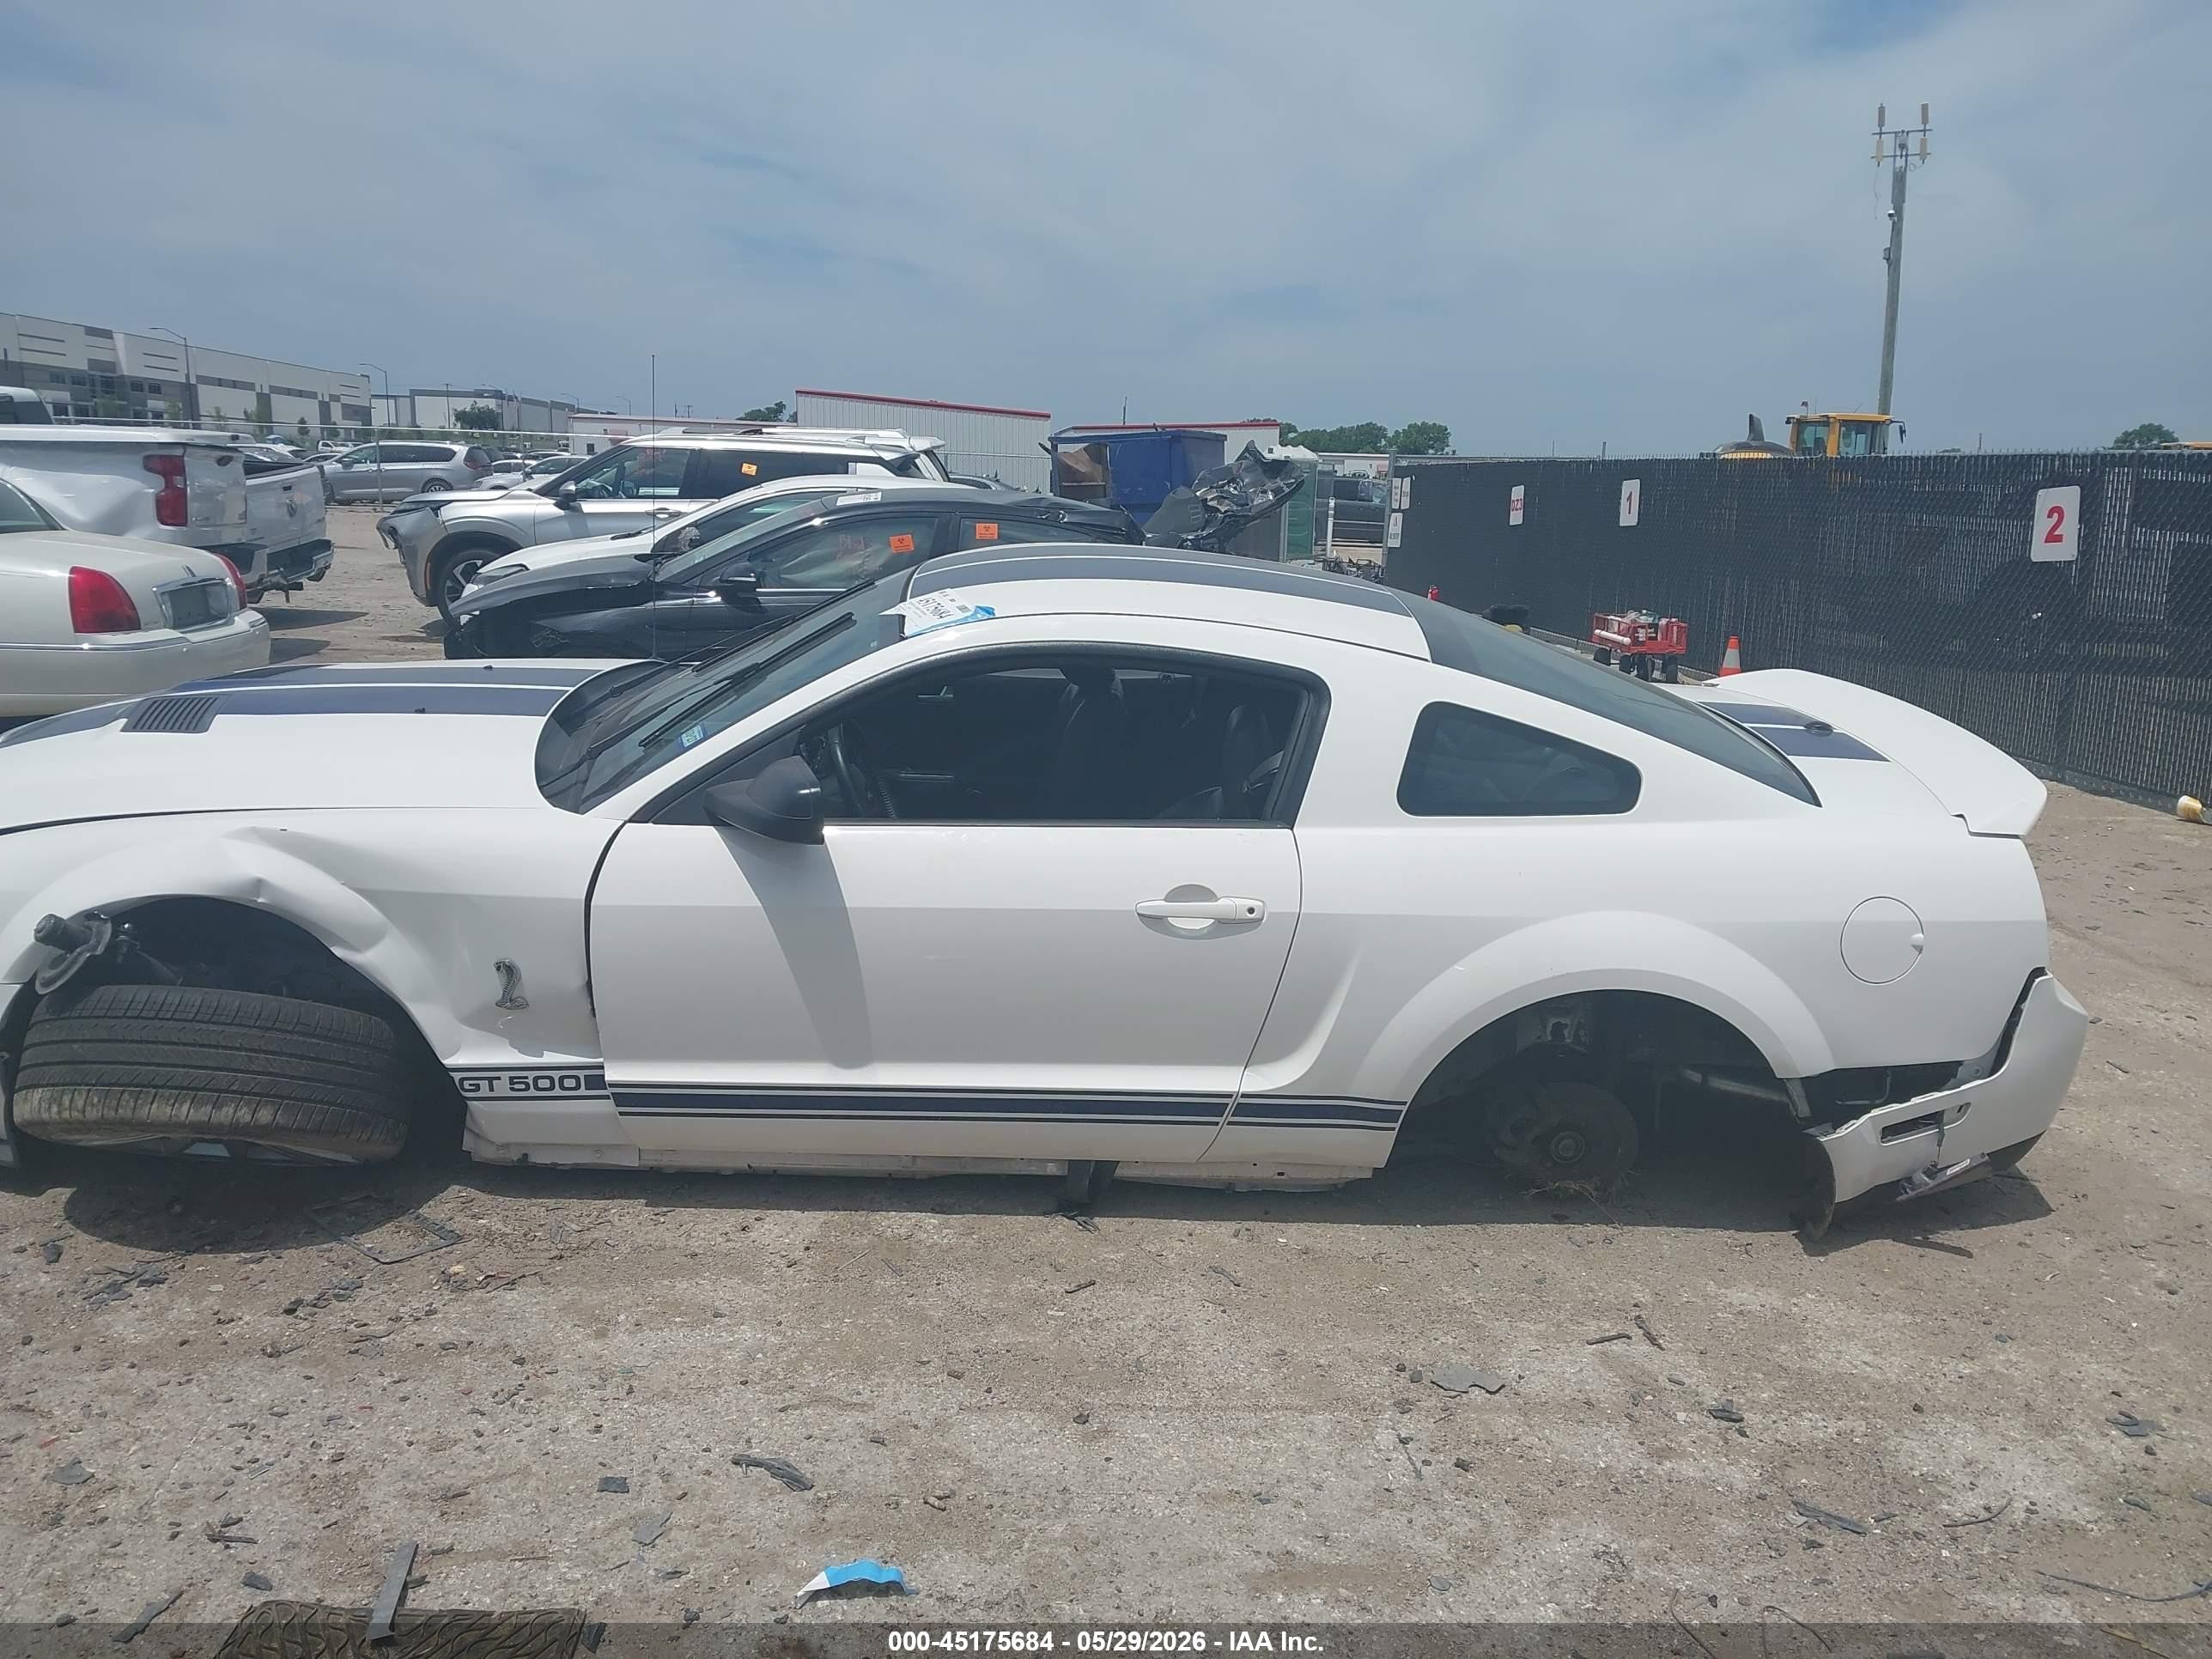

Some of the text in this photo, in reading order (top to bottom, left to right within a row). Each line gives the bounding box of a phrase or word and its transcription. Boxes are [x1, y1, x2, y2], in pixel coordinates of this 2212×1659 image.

[1626, 491, 1632, 514] 1
[2045, 505, 2065, 543] 2
[458, 1075, 581, 1093] GT 500
